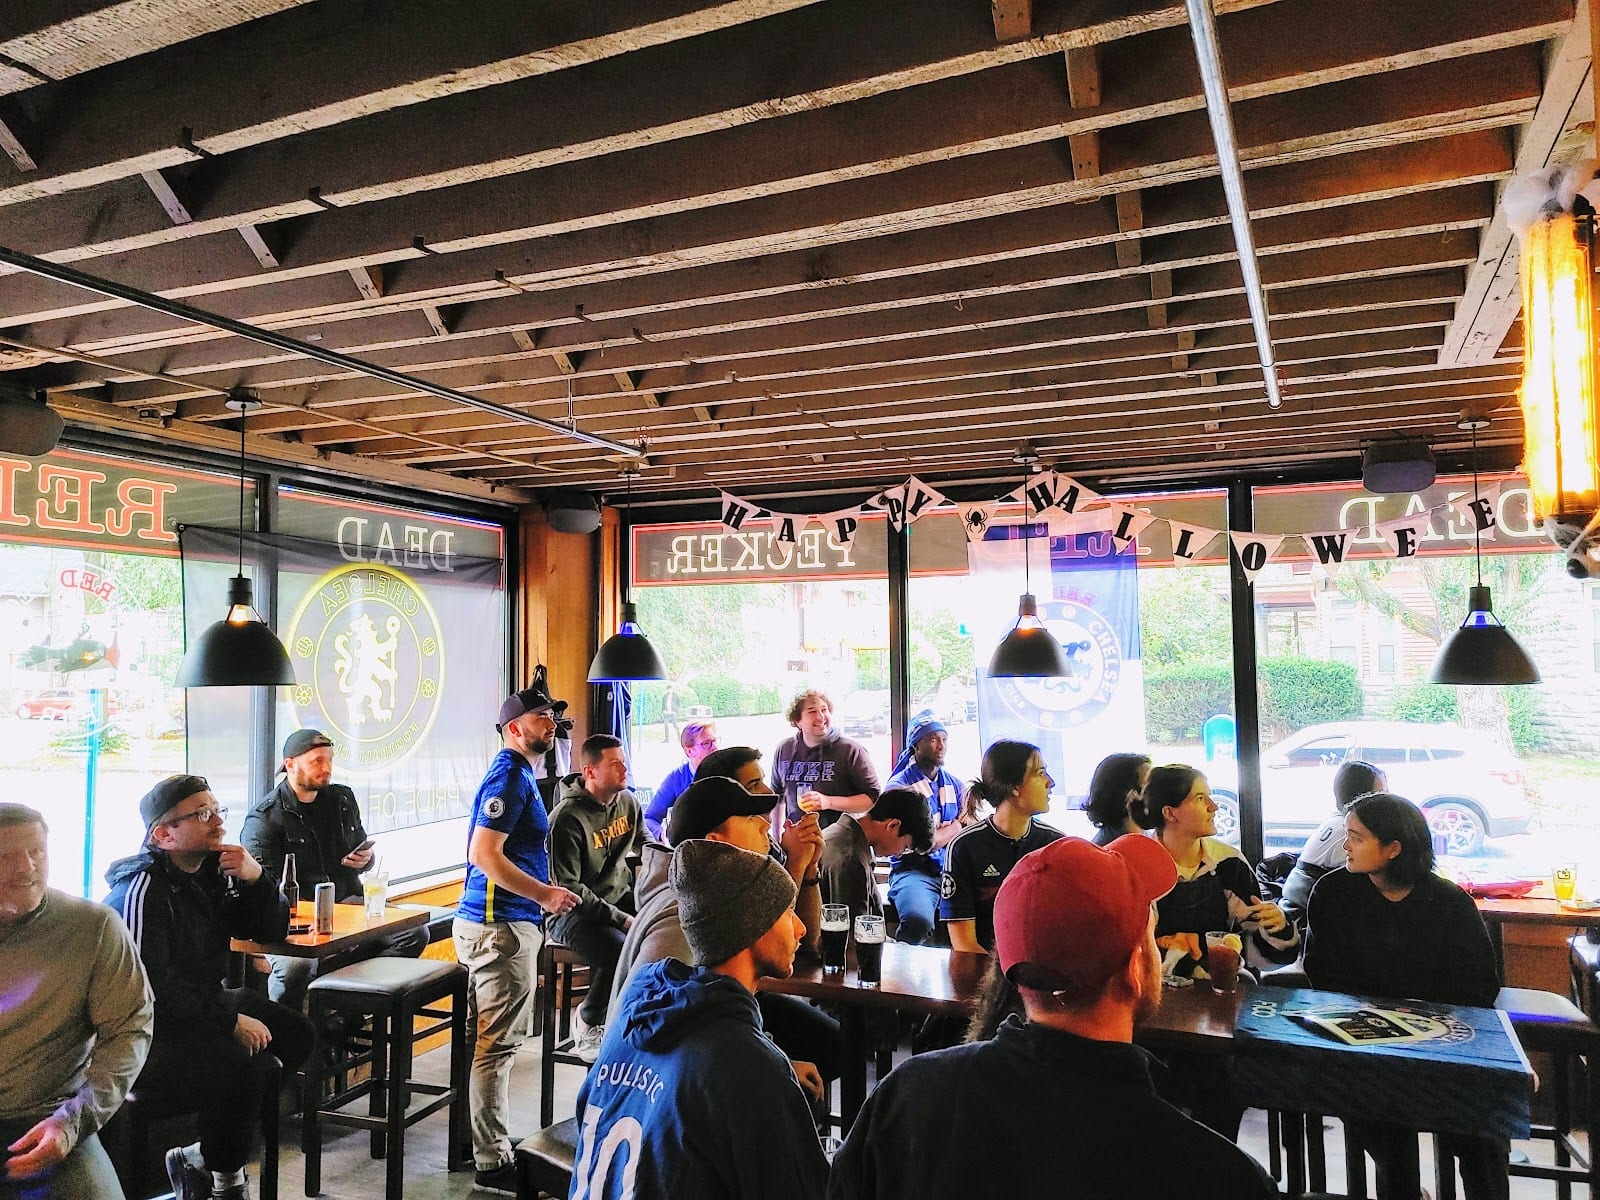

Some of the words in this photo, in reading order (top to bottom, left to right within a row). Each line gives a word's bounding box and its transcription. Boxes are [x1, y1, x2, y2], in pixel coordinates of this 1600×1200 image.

[722, 488, 933, 543] HAPPY
[596, 1060, 664, 1104] PULISIC
[568, 1103, 643, 1200] 10
